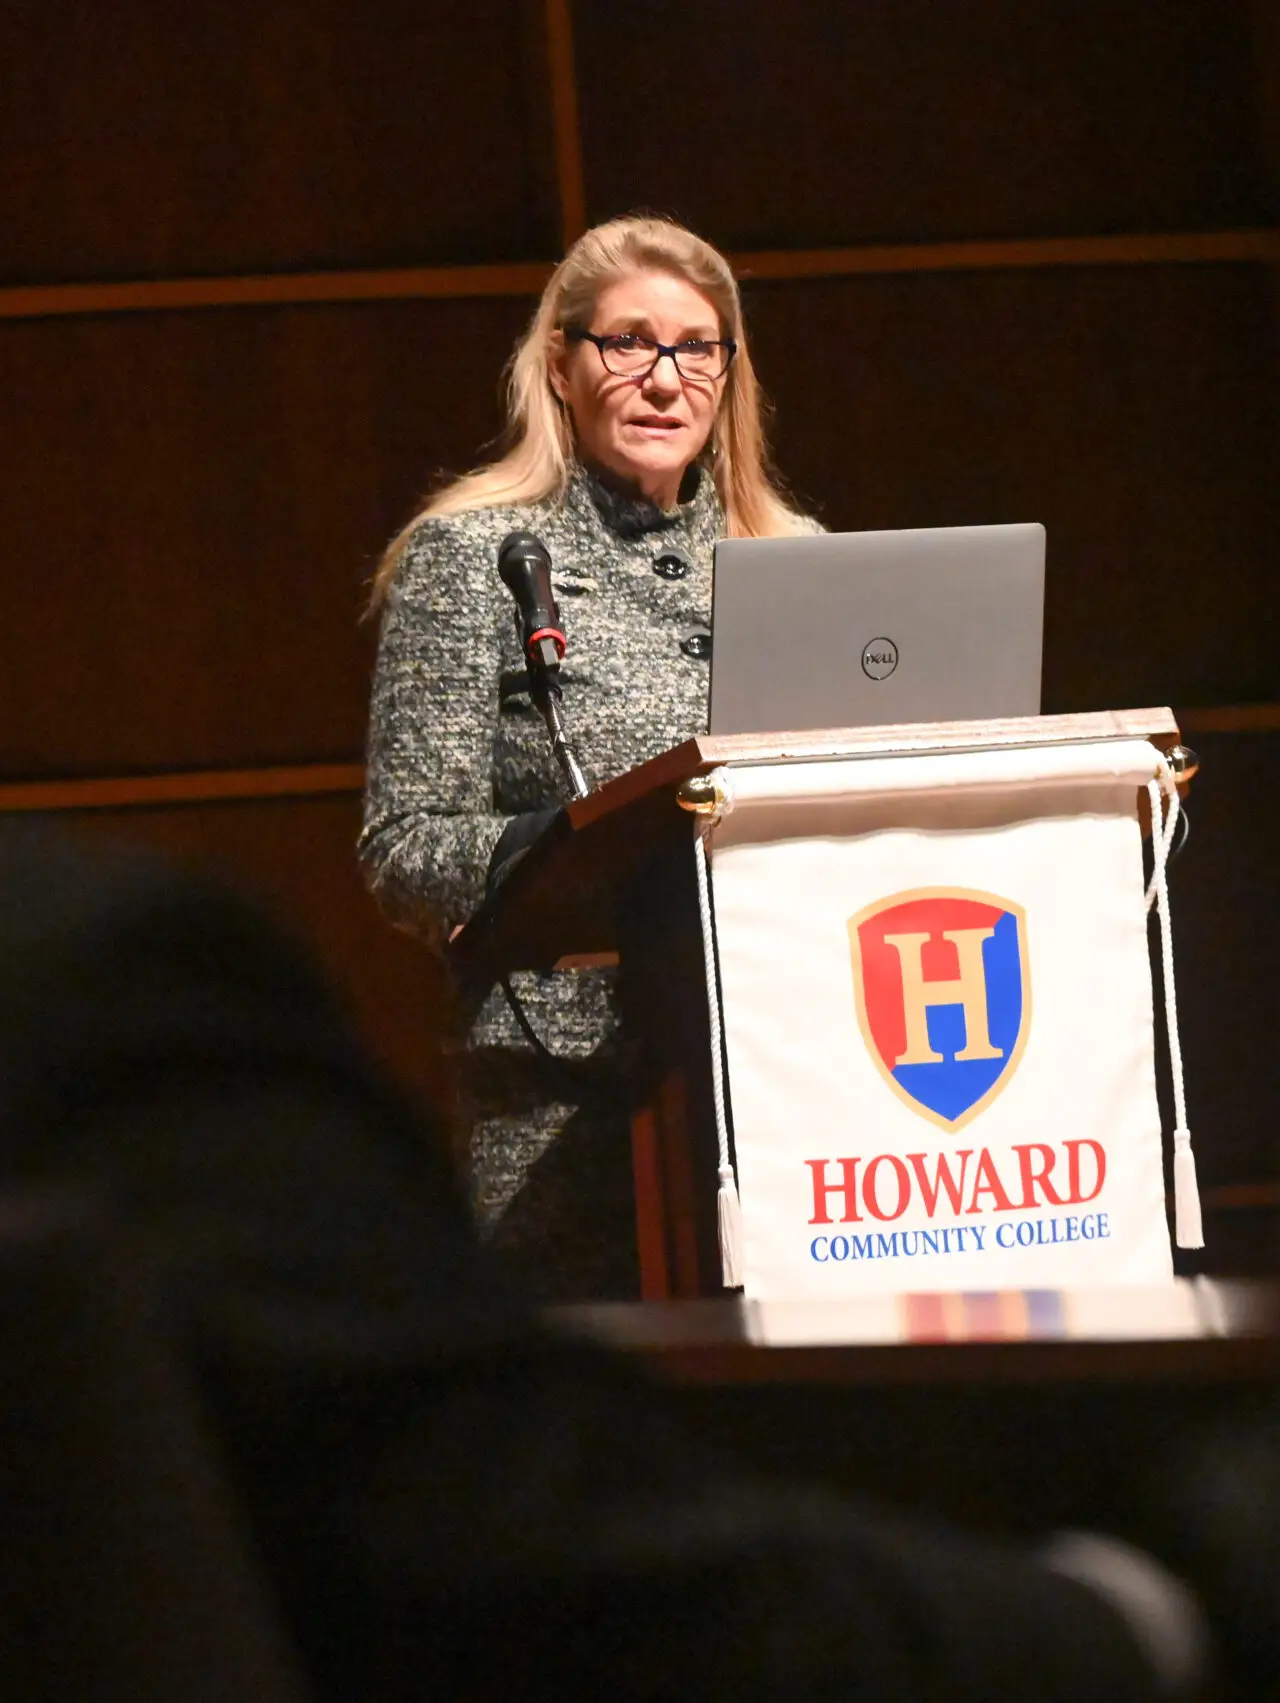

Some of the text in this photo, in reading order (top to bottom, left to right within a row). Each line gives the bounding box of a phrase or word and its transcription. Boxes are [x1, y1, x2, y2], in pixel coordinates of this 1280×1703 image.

[866, 653, 894, 664] DELL
[884, 927, 1004, 1065] H
[804, 1138, 1107, 1225] HOWARD
[810, 1213, 1111, 1262] COMMUNITY COLLEGE
